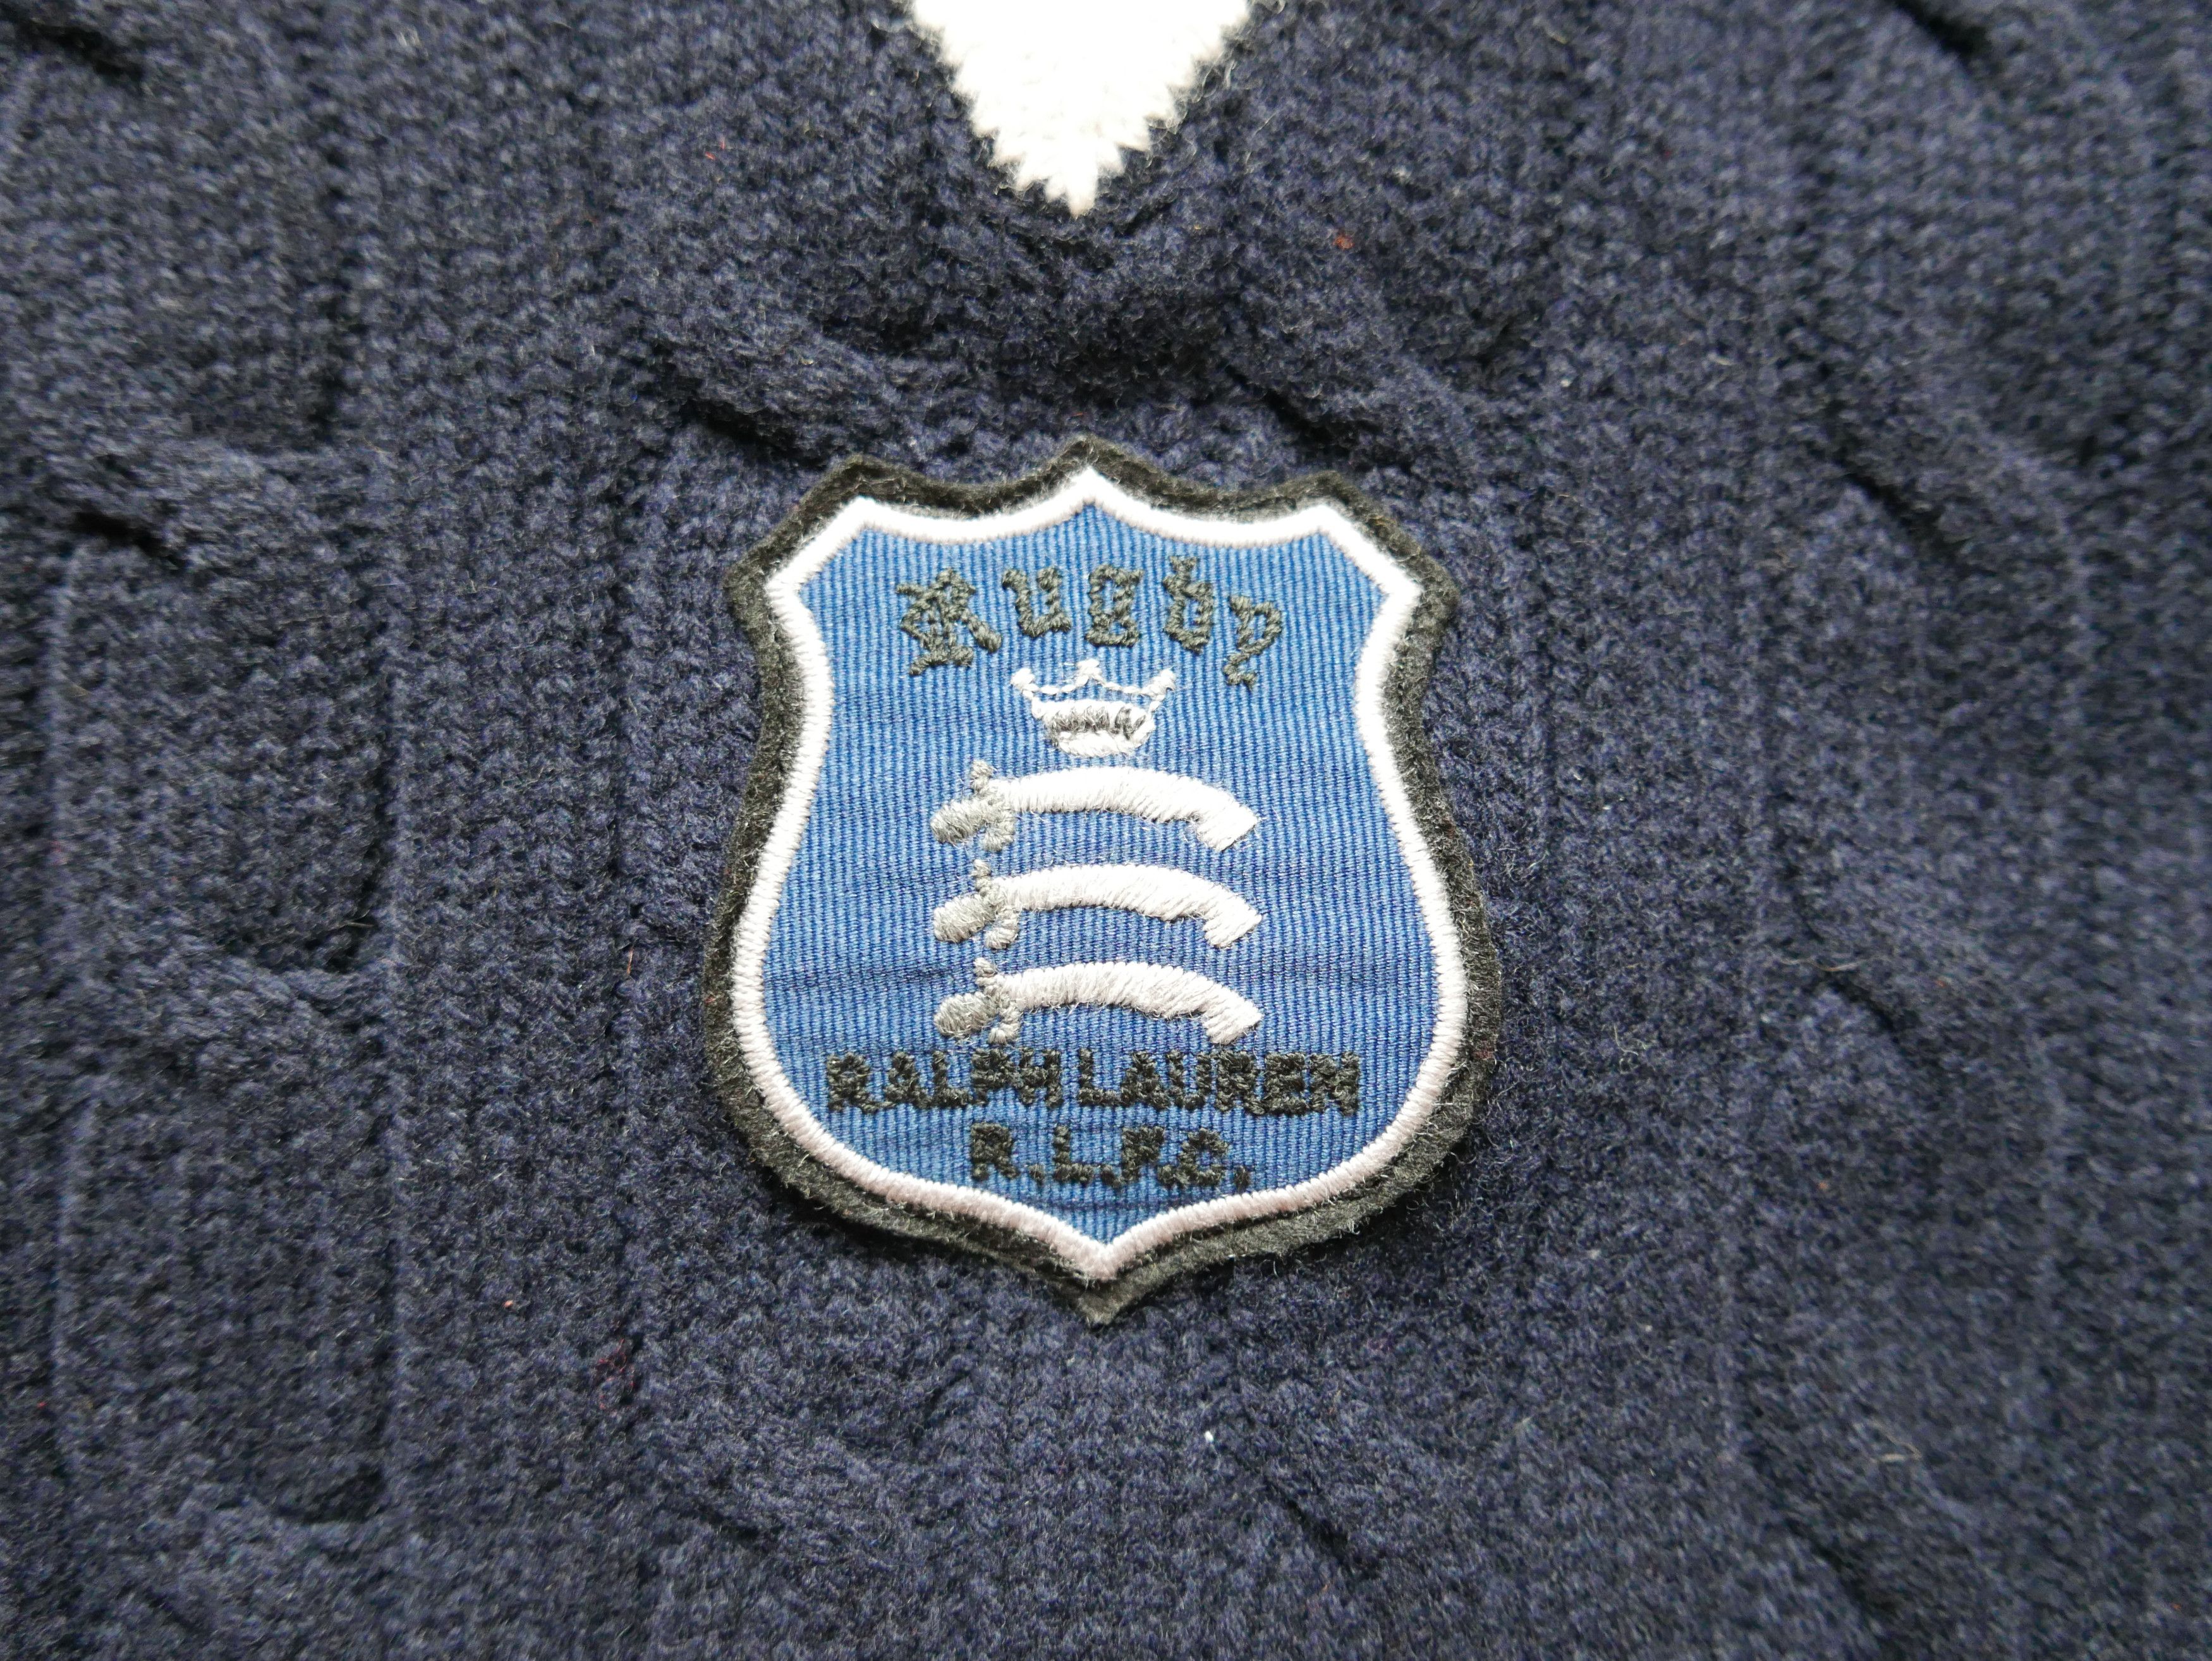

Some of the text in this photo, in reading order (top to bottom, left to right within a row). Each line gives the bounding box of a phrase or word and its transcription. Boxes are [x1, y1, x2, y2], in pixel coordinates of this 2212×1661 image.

[896, 555, 1282, 688] Rugby
[827, 1047, 1361, 1117] RALPH LAUREN
